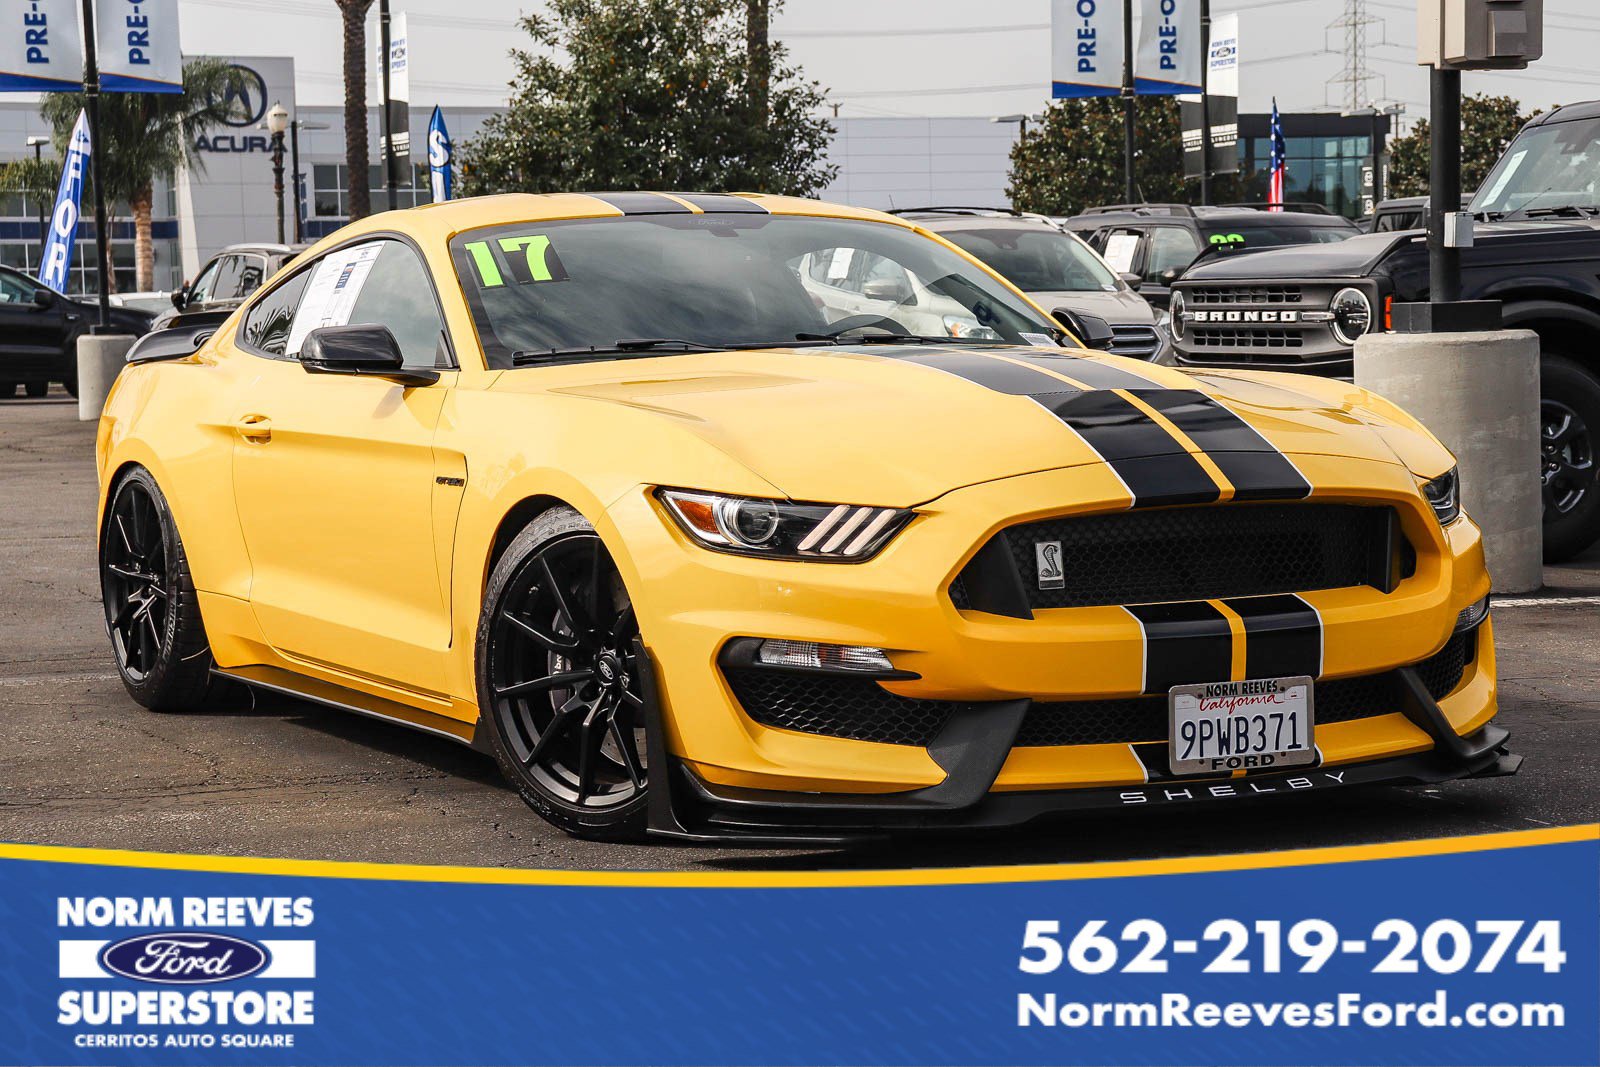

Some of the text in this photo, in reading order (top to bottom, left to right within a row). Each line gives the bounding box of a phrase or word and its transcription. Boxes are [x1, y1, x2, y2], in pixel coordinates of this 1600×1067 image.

[24, 0, 49, 63] PRE-
[126, 0, 150, 64] PRE-
[1076, 0, 1096, 72] PRE-O
[1159, 0, 1176, 69] PRE-O
[464, 234, 551, 287] 17
[1195, 311, 1297, 322] BRONCO
[1200, 694, 1284, 715] California
[1206, 681, 1278, 697] NORM REEVES
[1181, 712, 1302, 759] 9PWB371
[1212, 755, 1275, 770] FORD
[1119, 772, 1344, 803] SHELBY
